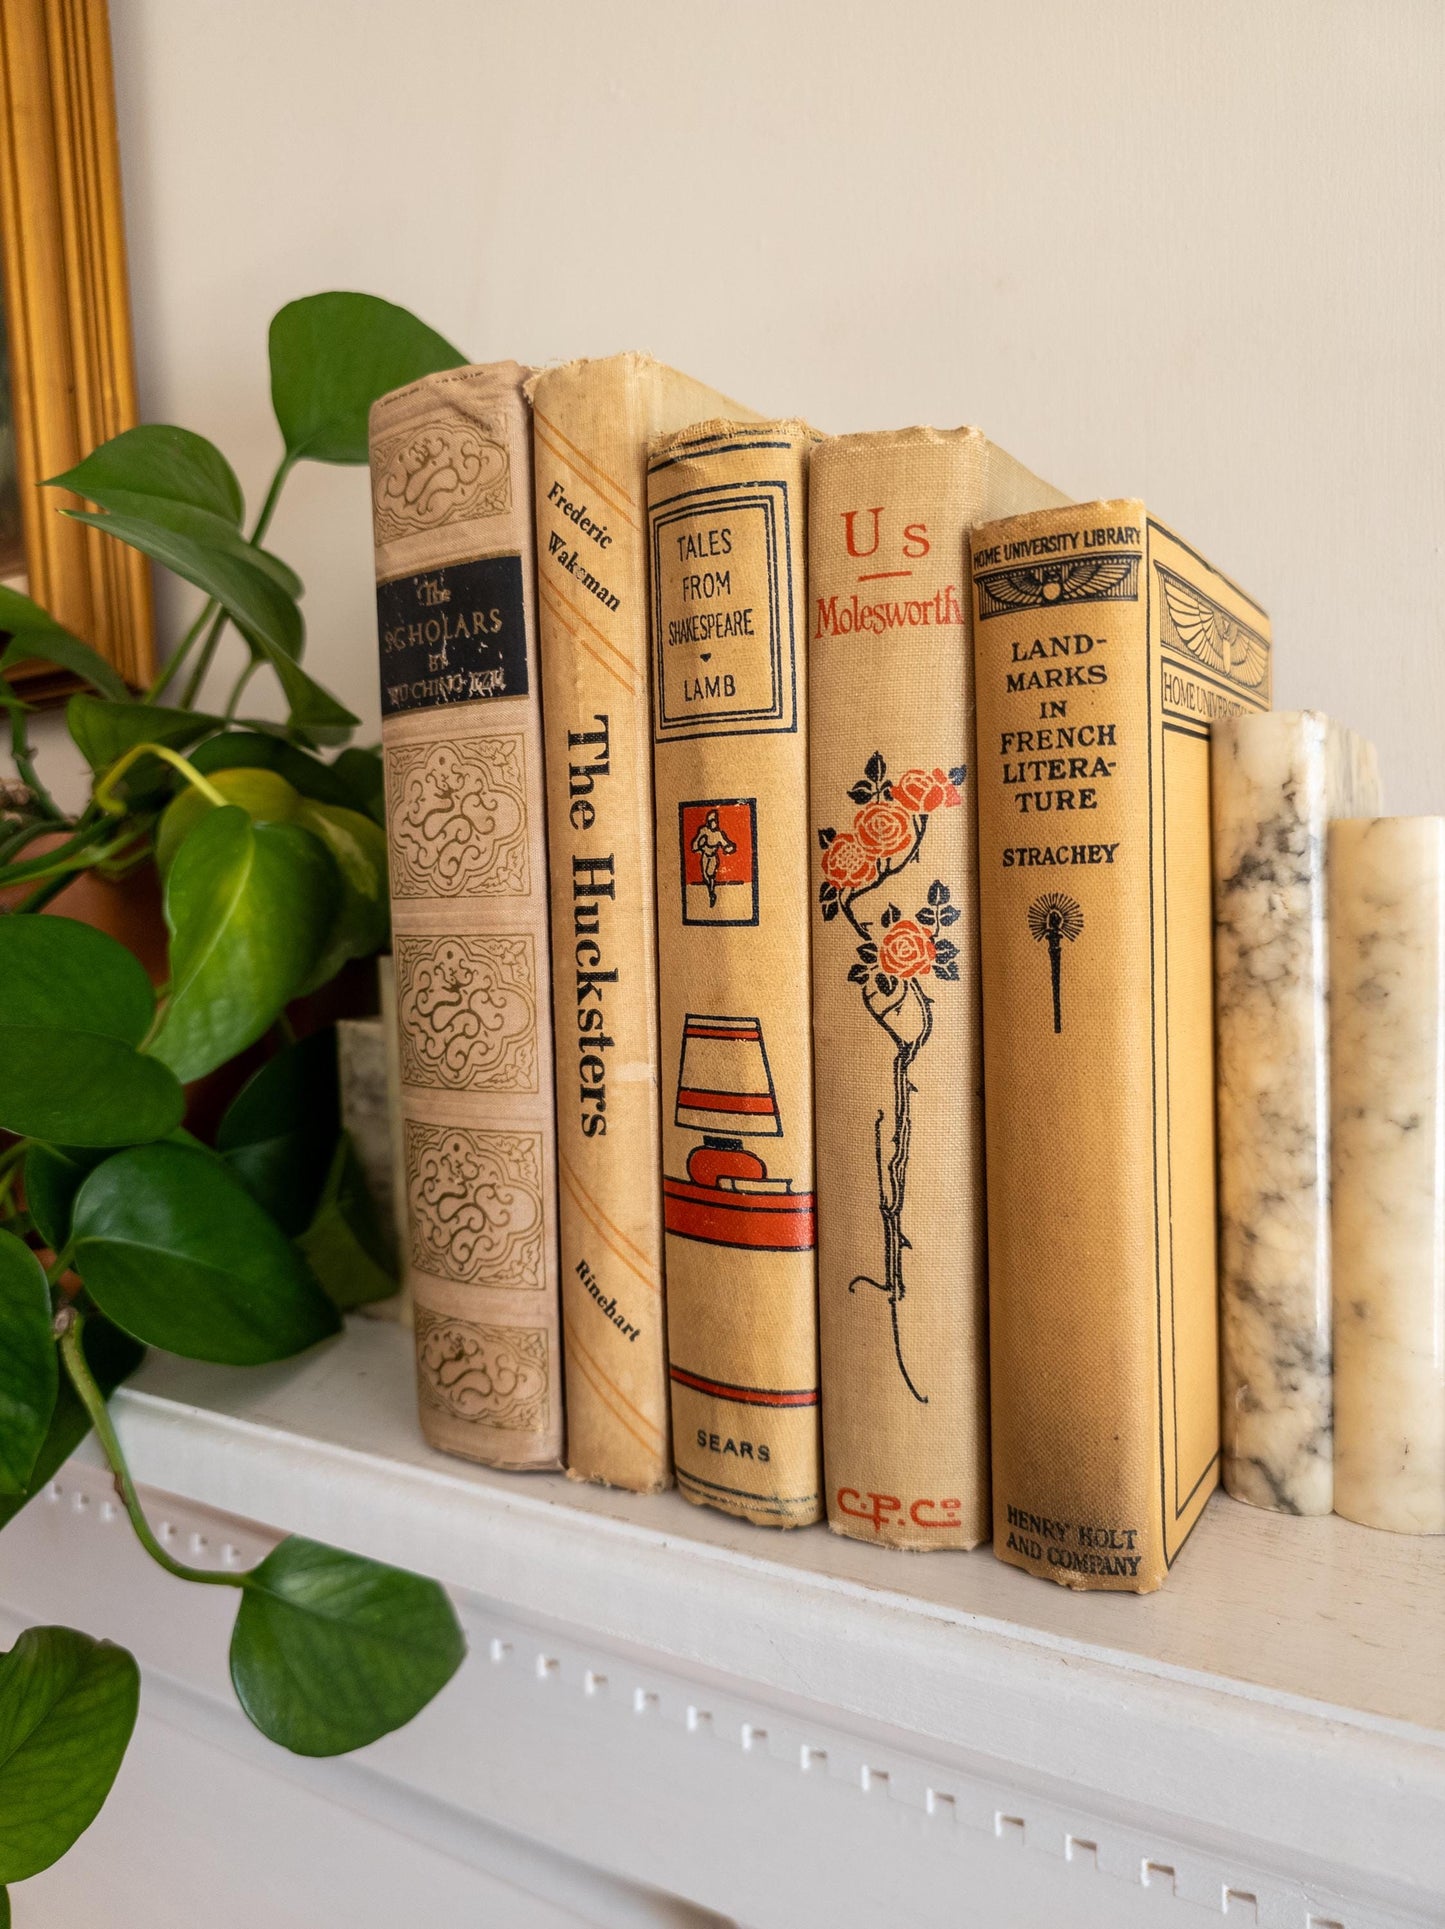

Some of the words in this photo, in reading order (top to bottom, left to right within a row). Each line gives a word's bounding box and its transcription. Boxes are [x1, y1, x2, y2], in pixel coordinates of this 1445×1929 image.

[547, 481, 613, 549] Frederic
[840, 507, 930, 558] Us
[677, 528, 733, 562] TALES
[974, 546, 1002, 570] HOME
[1004, 531, 1081, 561] UNIVERSITY
[1084, 526, 1142, 548] LIBRARY
[548, 530, 621, 612] Wakeman
[682, 570, 731, 602] FROM
[417, 577, 452, 606] The
[668, 608, 755, 646] SHAKESPEARE
[814, 585, 965, 639] Molesworth
[384, 608, 503, 653] SCHOLARS
[1011, 634, 1108, 663] LAND-
[428, 653, 449, 672] BY
[1006, 665, 1108, 693] MARKS
[684, 674, 736, 702] LAMB
[1164, 671, 1196, 710] HOME
[1039, 700, 1068, 719] IN
[1000, 724, 1117, 755] FRENCH
[567, 713, 610, 830] The
[1003, 757, 1117, 784] LITERA-
[1015, 788, 1098, 813] TURE
[1003, 843, 1120, 867] STRACHEY
[572, 853, 619, 1136] Hucksters
[575, 1258, 641, 1342] Rinehart
[697, 1428, 770, 1462] SEARS
[1007, 1503, 1072, 1543] HENRY
[1078, 1526, 1138, 1550] HOLT
[1006, 1531, 1042, 1560] AND
[1047, 1548, 1142, 1577] COMPANY
